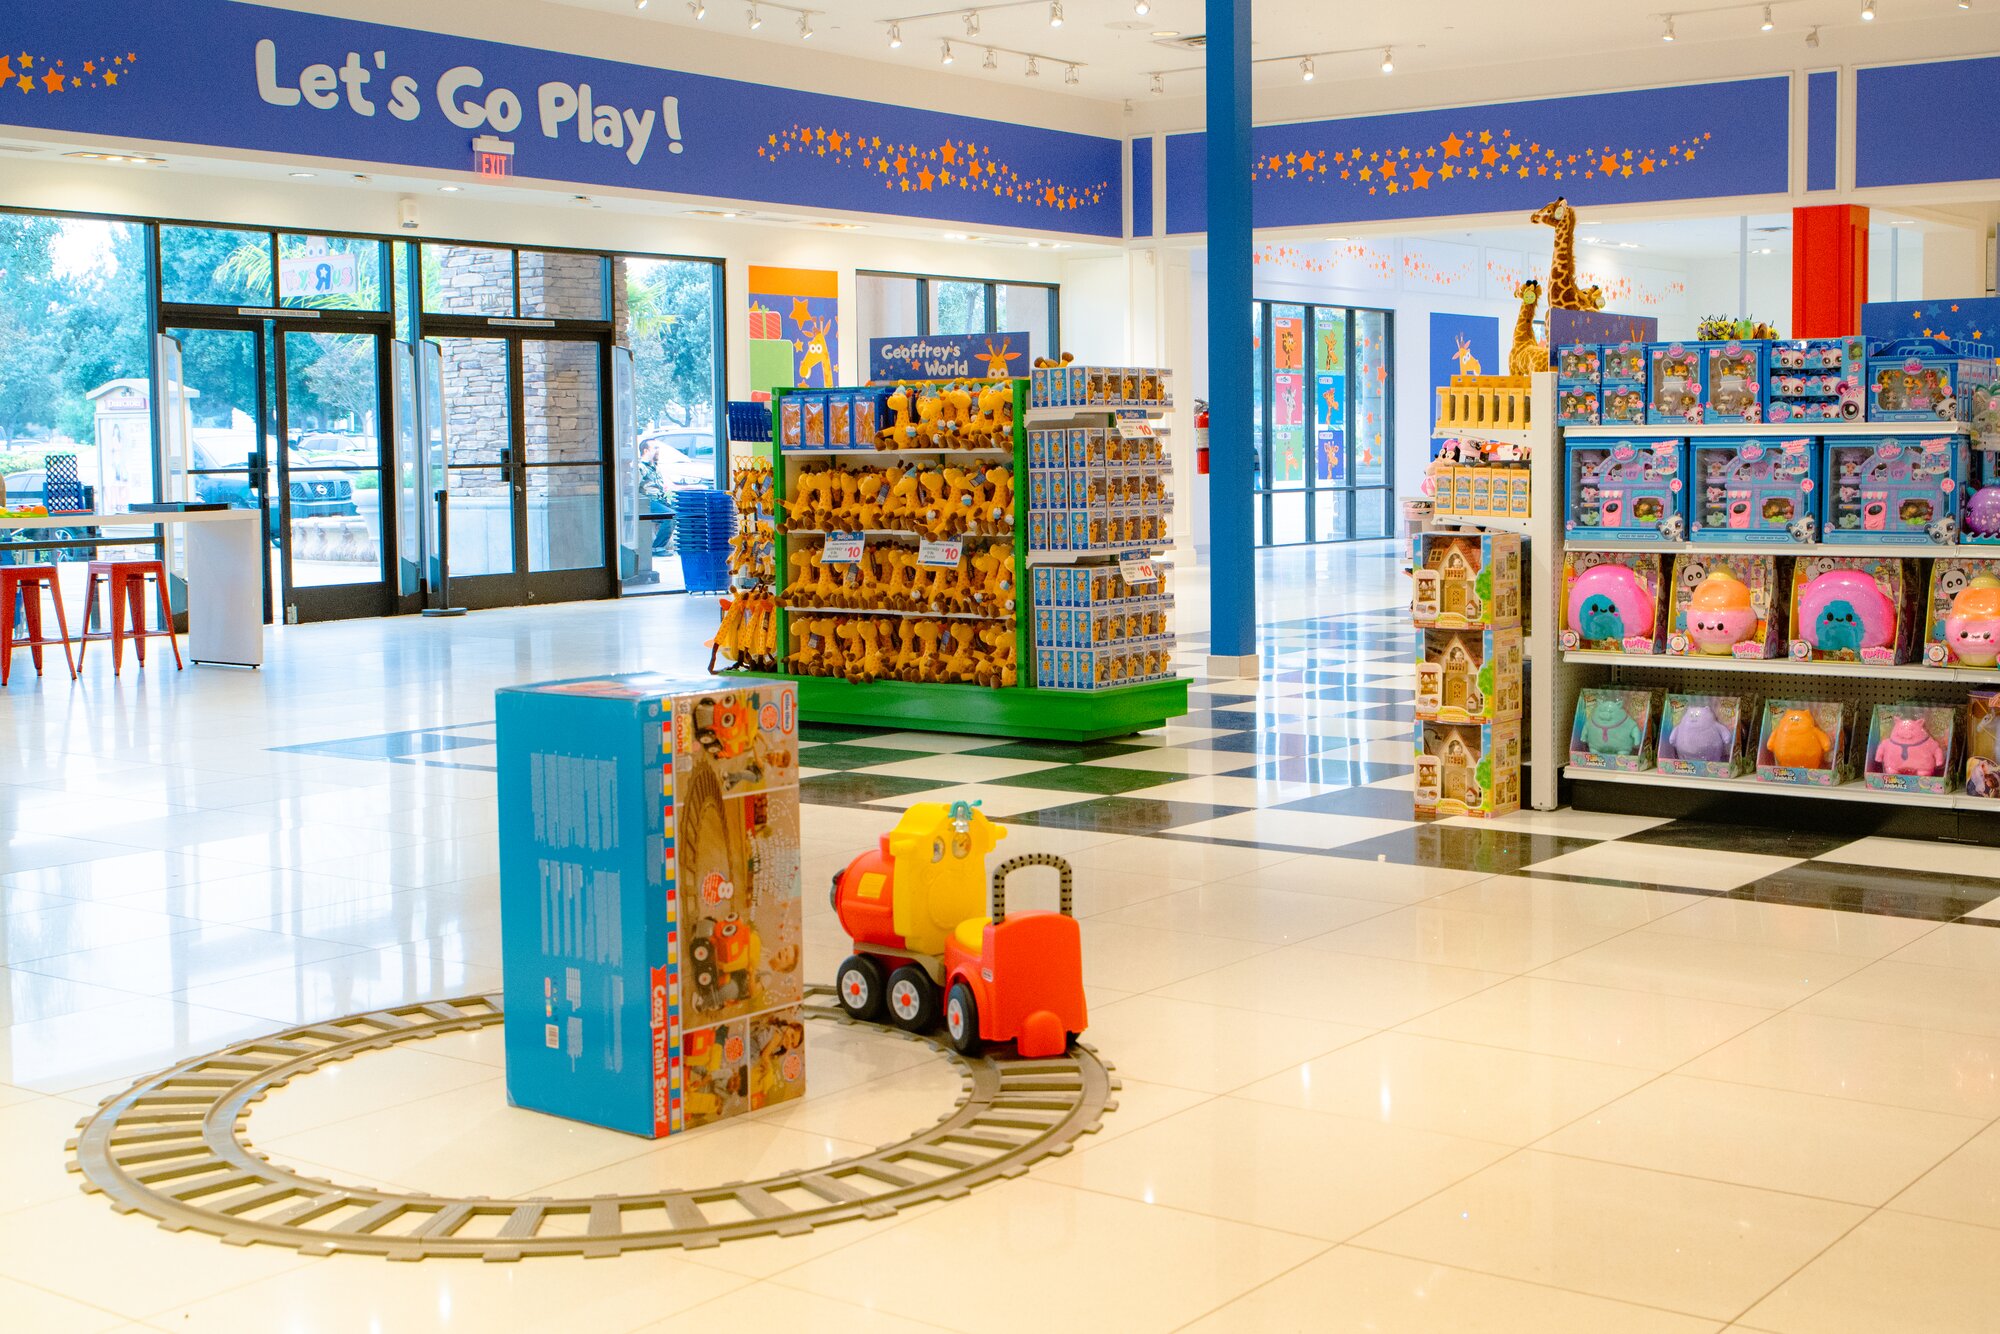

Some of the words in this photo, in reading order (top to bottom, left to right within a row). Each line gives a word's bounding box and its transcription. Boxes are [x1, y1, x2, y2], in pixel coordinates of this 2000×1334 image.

[255, 39, 421, 121] Let's
[436, 66, 523, 132] Go
[481, 153, 507, 179] EXIT
[881, 341, 961, 361] Geoffrey's
[924, 359, 969, 377] World
[650, 984, 667, 1029] Cozy
[654, 1029, 667, 1076] Train
[655, 1077, 668, 1123] Scoot
